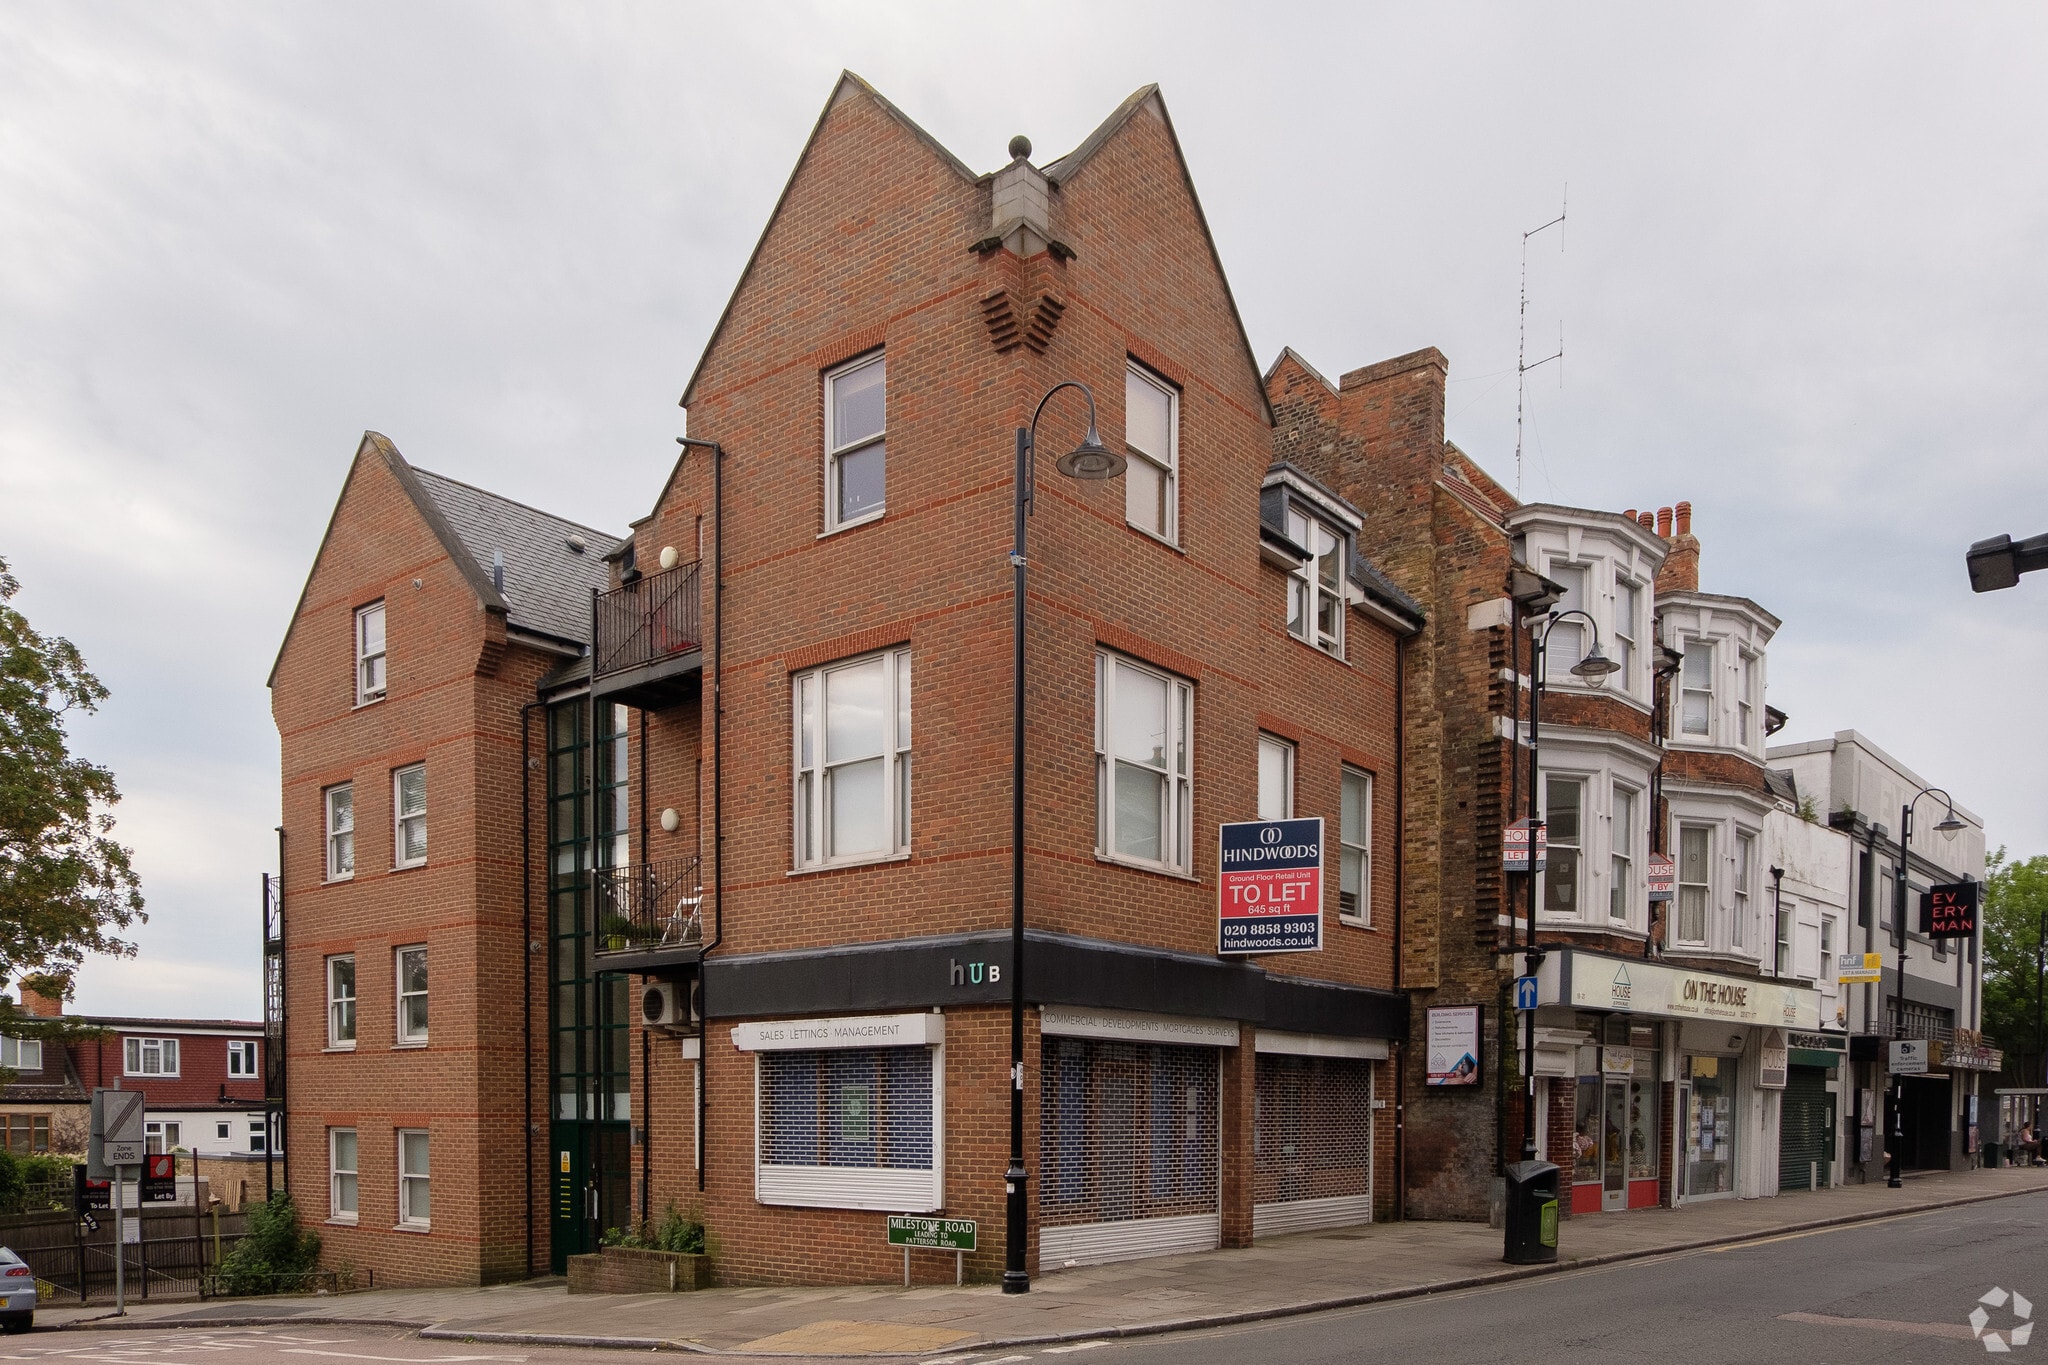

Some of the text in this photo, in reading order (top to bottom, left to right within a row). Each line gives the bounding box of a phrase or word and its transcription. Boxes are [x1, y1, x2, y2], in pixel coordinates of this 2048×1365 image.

[1224, 844, 1318, 862] HINDWOODS
[1508, 852, 1525, 860] LET
[1275, 872, 1295, 880] Retail
[1296, 871, 1311, 879] Unit
[1229, 882, 1311, 904] TO LET
[1657, 883, 1669, 891] BY
[1933, 892, 1956, 904] EV
[1248, 903, 1291, 915] 645 sq ft
[1932, 905, 1968, 918] ERY
[1224, 922, 1315, 936] 020 8858 9303
[1932, 920, 1973, 932] MAN
[1224, 935, 1314, 948] hindwoods.co.uk
[1840, 955, 1856, 965] hnf
[1612, 985, 1631, 998] HOUSE
[1683, 979, 1747, 1006] ON THE HOUSE
[1783, 1006, 1796, 1018] HOUSE
[1044, 1013, 1235, 1038] COMMERCIAL DEVELOPMENTS MORTGAGES SURVEYS
[760, 1024, 900, 1041] SALES LETTINGS MANAGEMENT
[1763, 1050, 1786, 1069] HOUSE
[113, 1152, 135, 1160] ENDS
[165, 1193, 174, 1201] By
[83, 1212, 98, 1230] Let By
[890, 1218, 973, 1233] MILESTONE ROAD
[914, 1230, 938, 1239] LEADING
[905, 1236, 938, 1246] PATTERSON
